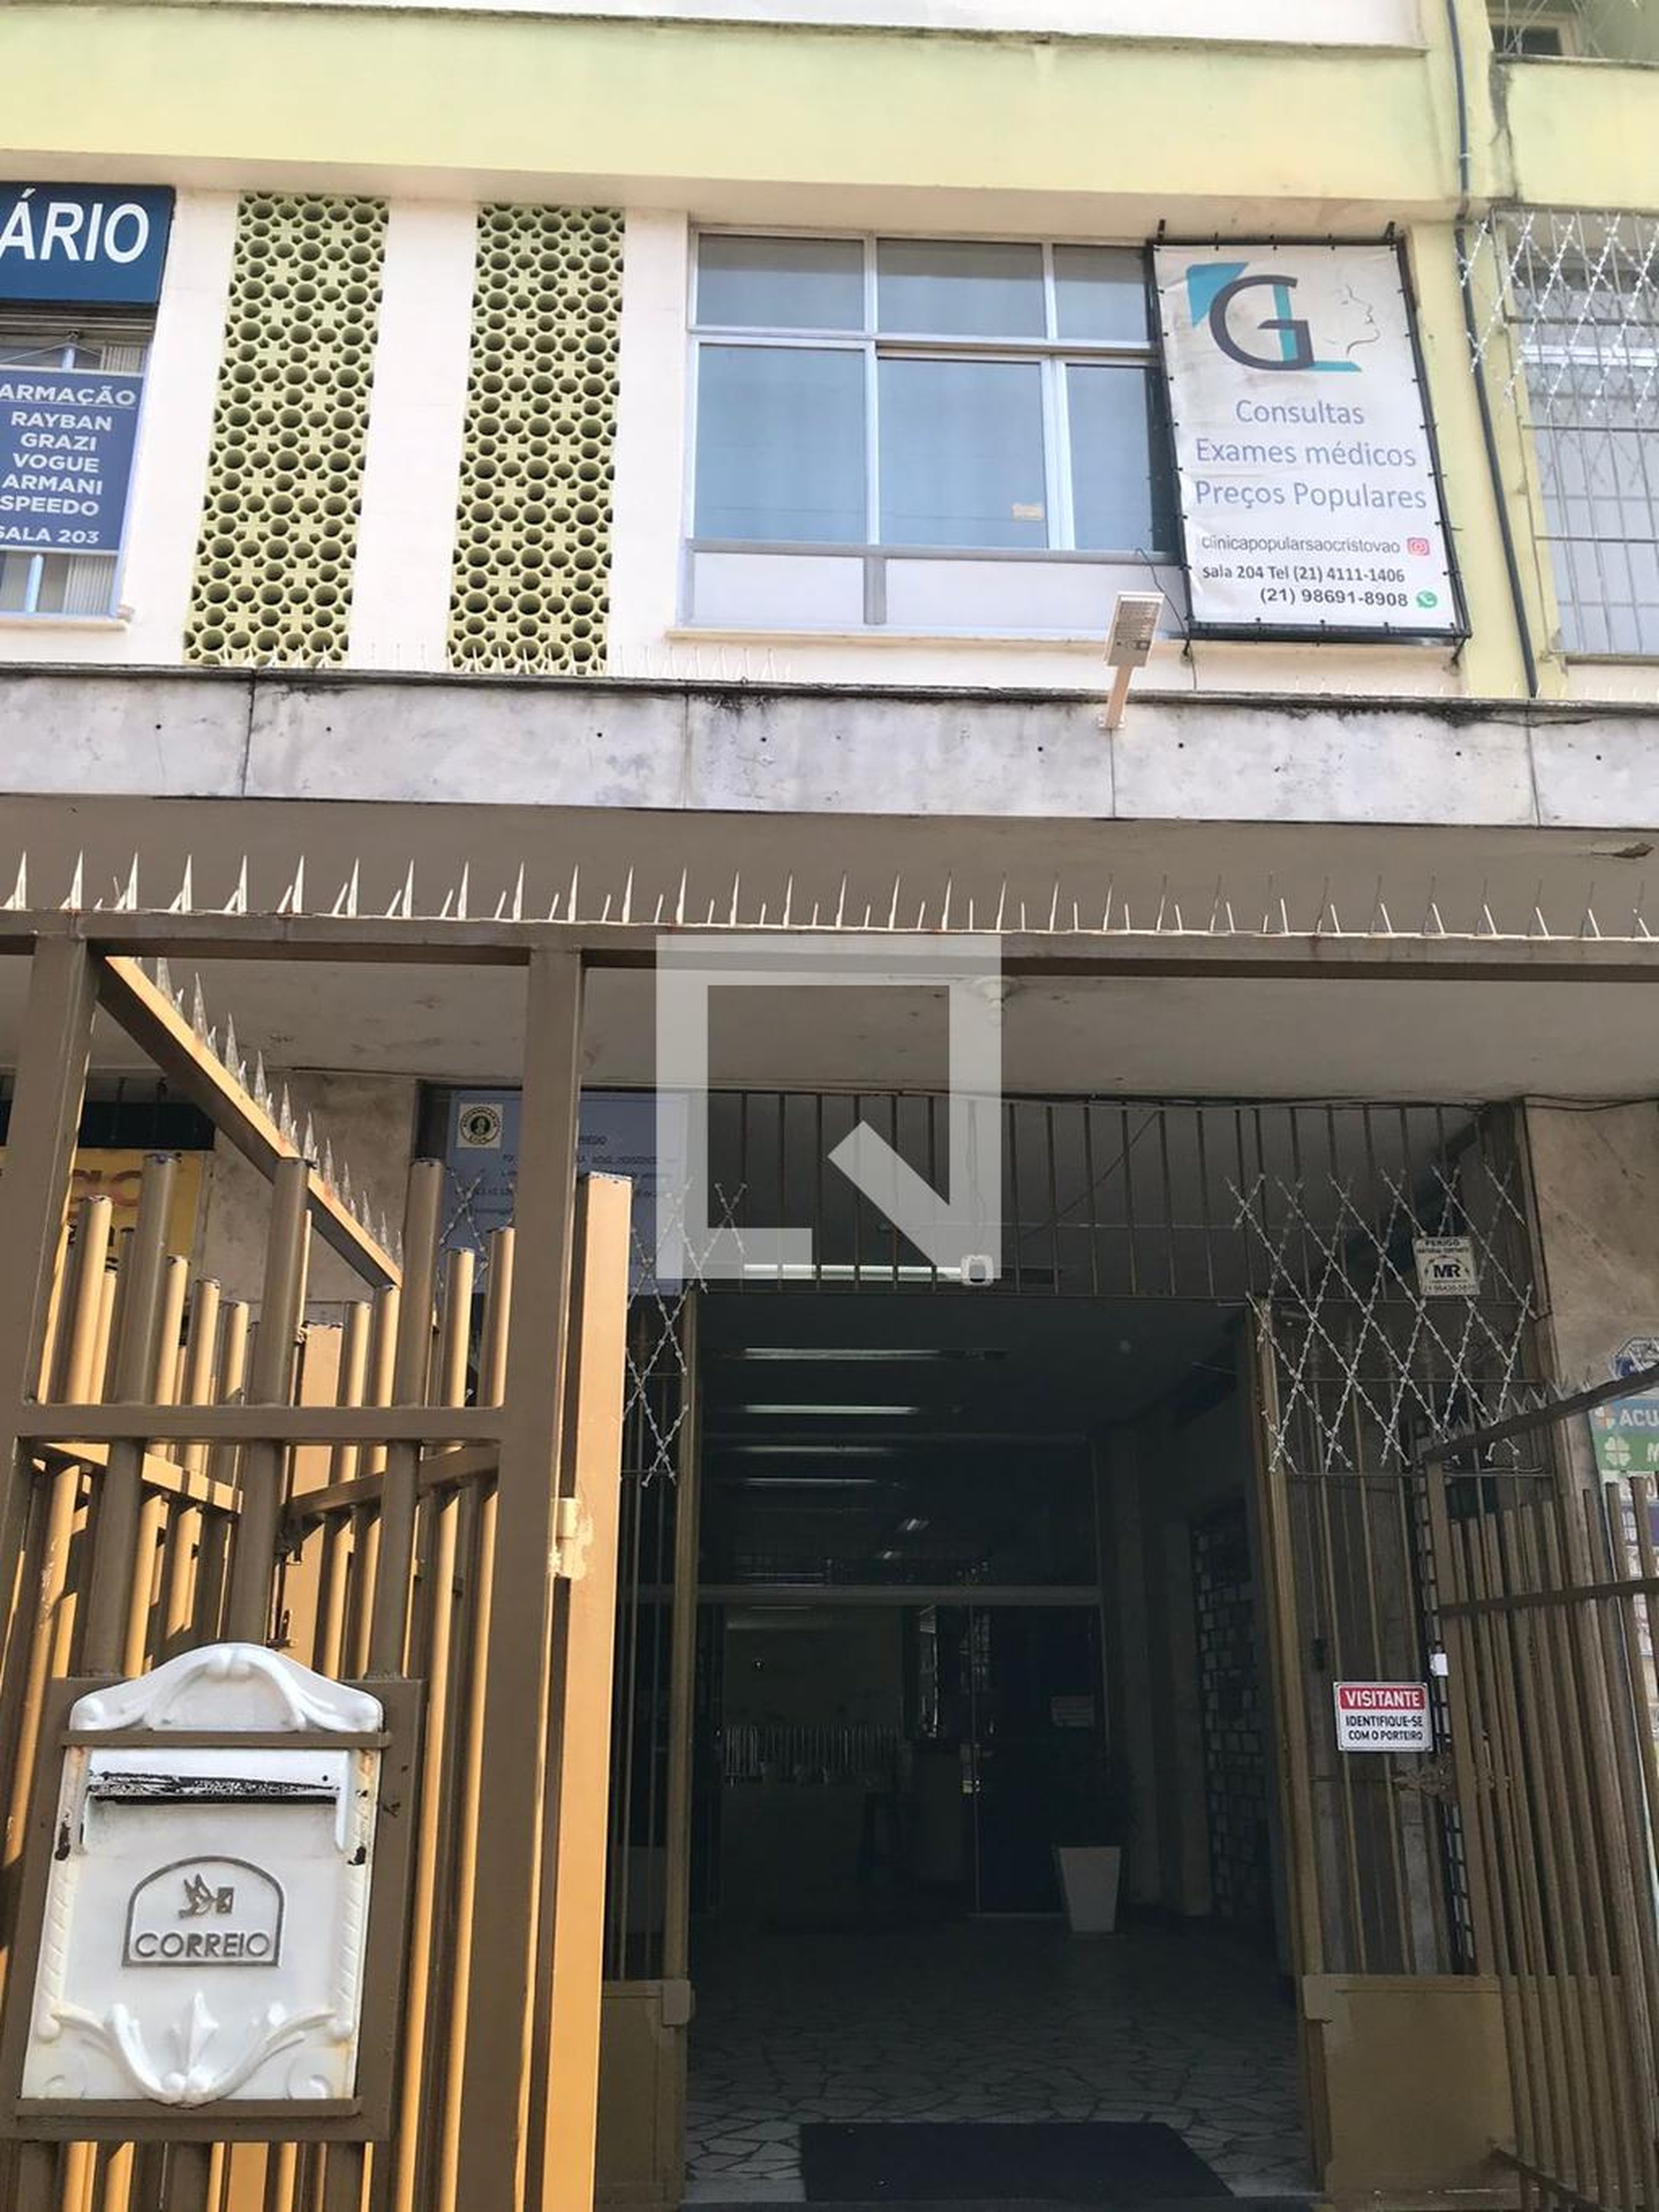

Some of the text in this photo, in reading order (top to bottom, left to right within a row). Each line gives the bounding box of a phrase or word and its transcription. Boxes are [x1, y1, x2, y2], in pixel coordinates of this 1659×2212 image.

[0, 383, 136, 405] ARMAÇÃO
[11, 411, 112, 431] RAYBAN
[1236, 400, 1364, 424] Consultas
[20, 433, 97, 451] GRAZI
[1196, 438, 1416, 467] Exames médicos
[13, 453, 100, 473] VOGUE
[1, 474, 103, 495] ARMANI
[0, 495, 99, 516] SPEEDO
[1195, 481, 1427, 512] Preços Populares
[57, 529, 100, 544] 203
[1236, 565, 1264, 579] 204
[1268, 566, 1289, 579] Tel
[1294, 567, 1322, 582] (21)
[1327, 567, 1405, 582] 4111-1406
[1260, 587, 1408, 607] (21) 98691-8908
[1433, 1264, 1461, 1278] MR
[1345, 1690, 1421, 1707] VISITANTE
[1345, 1715, 1423, 1727] IDENTIFIQUE-SE
[1348, 1730, 1423, 1741] COM O PORTEIRO
[134, 1932, 270, 1958] CORREIO
